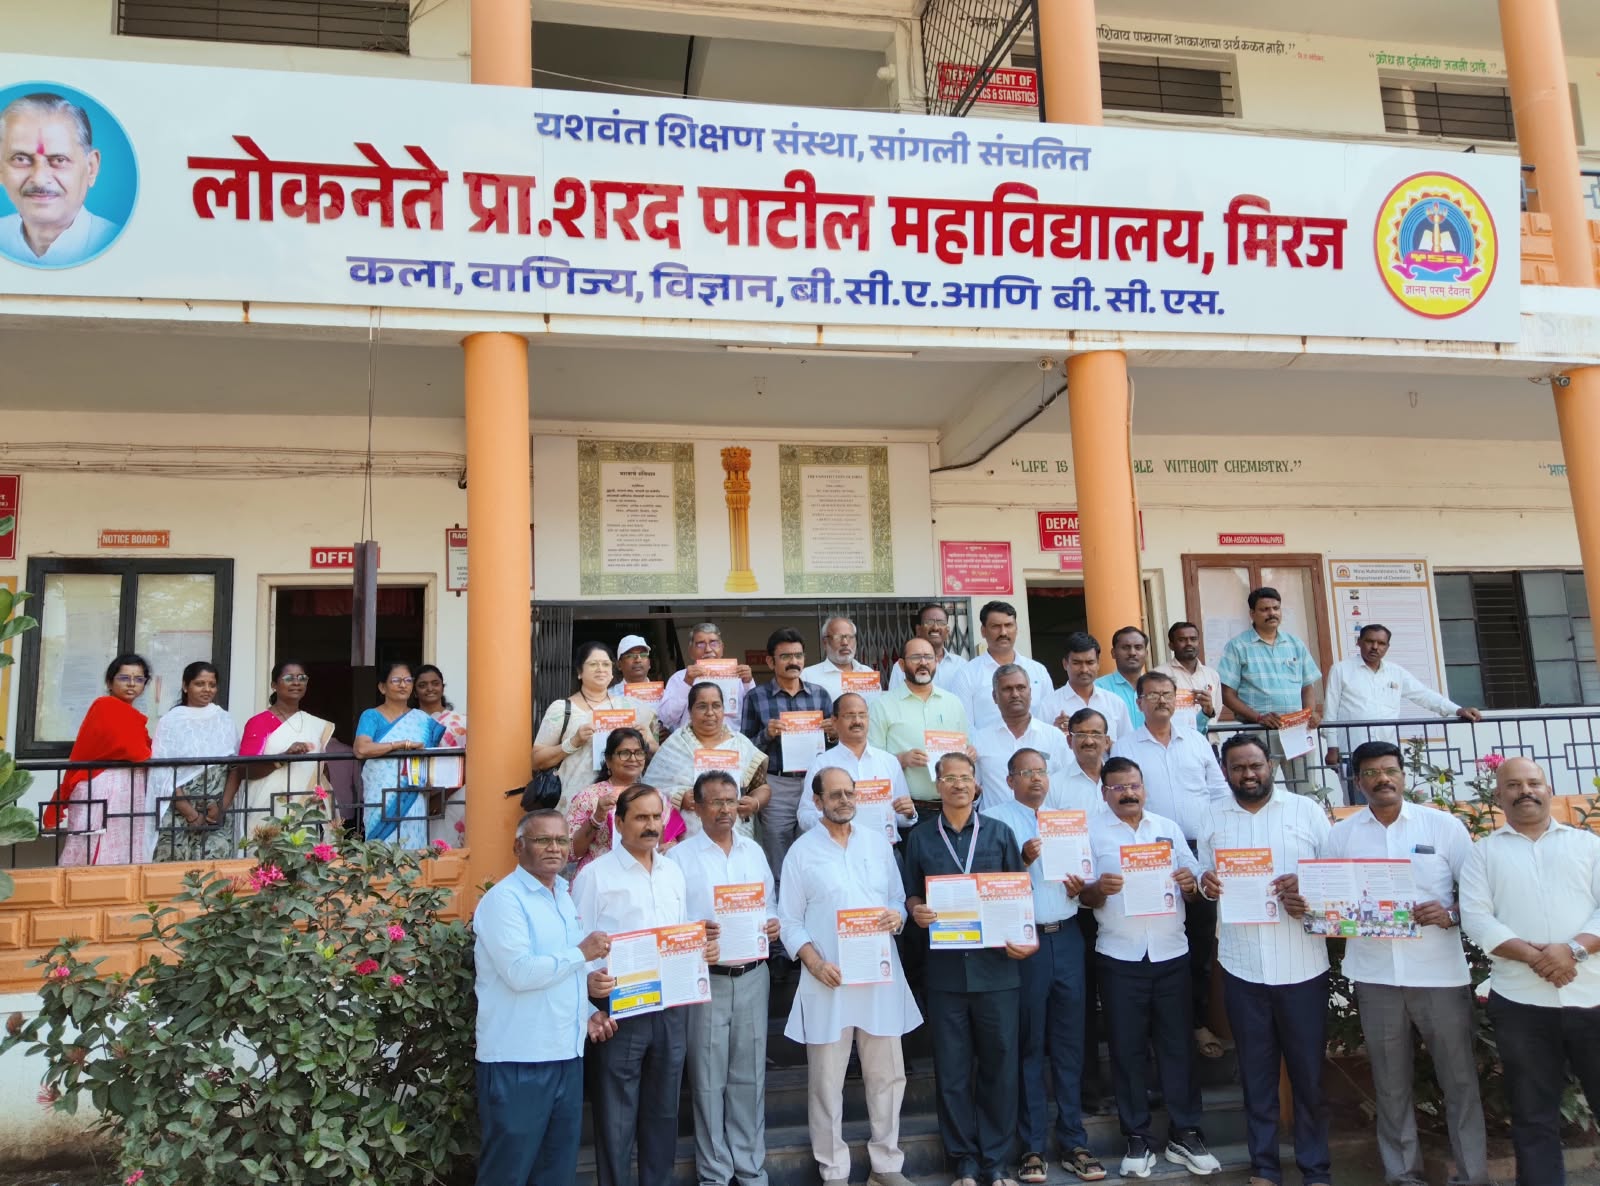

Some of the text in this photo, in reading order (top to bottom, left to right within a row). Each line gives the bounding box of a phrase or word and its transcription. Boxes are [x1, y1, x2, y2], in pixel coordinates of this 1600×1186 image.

[1018, 75, 1032, 87] OF
[998, 89, 1036, 104] STATISTICS
[535, 107, 1092, 173] यशवंत शिक्षण संस्था, सांगली संचलित
[187, 134, 449, 231] लोकनेते
[698, 169, 875, 252] पाटील
[887, 181, 1215, 276] महाविद्यालय,
[1223, 194, 1348, 271] मिरज
[1055, 460, 1069, 473] IS
[1133, 460, 1154, 473] BLE
[1163, 459, 1219, 473] WITHOUT
[102, 534, 130, 545] NOTICE
[452, 532, 467, 540] RAG
[1053, 534, 1080, 547] CHE
[315, 551, 353, 564] OFFI
